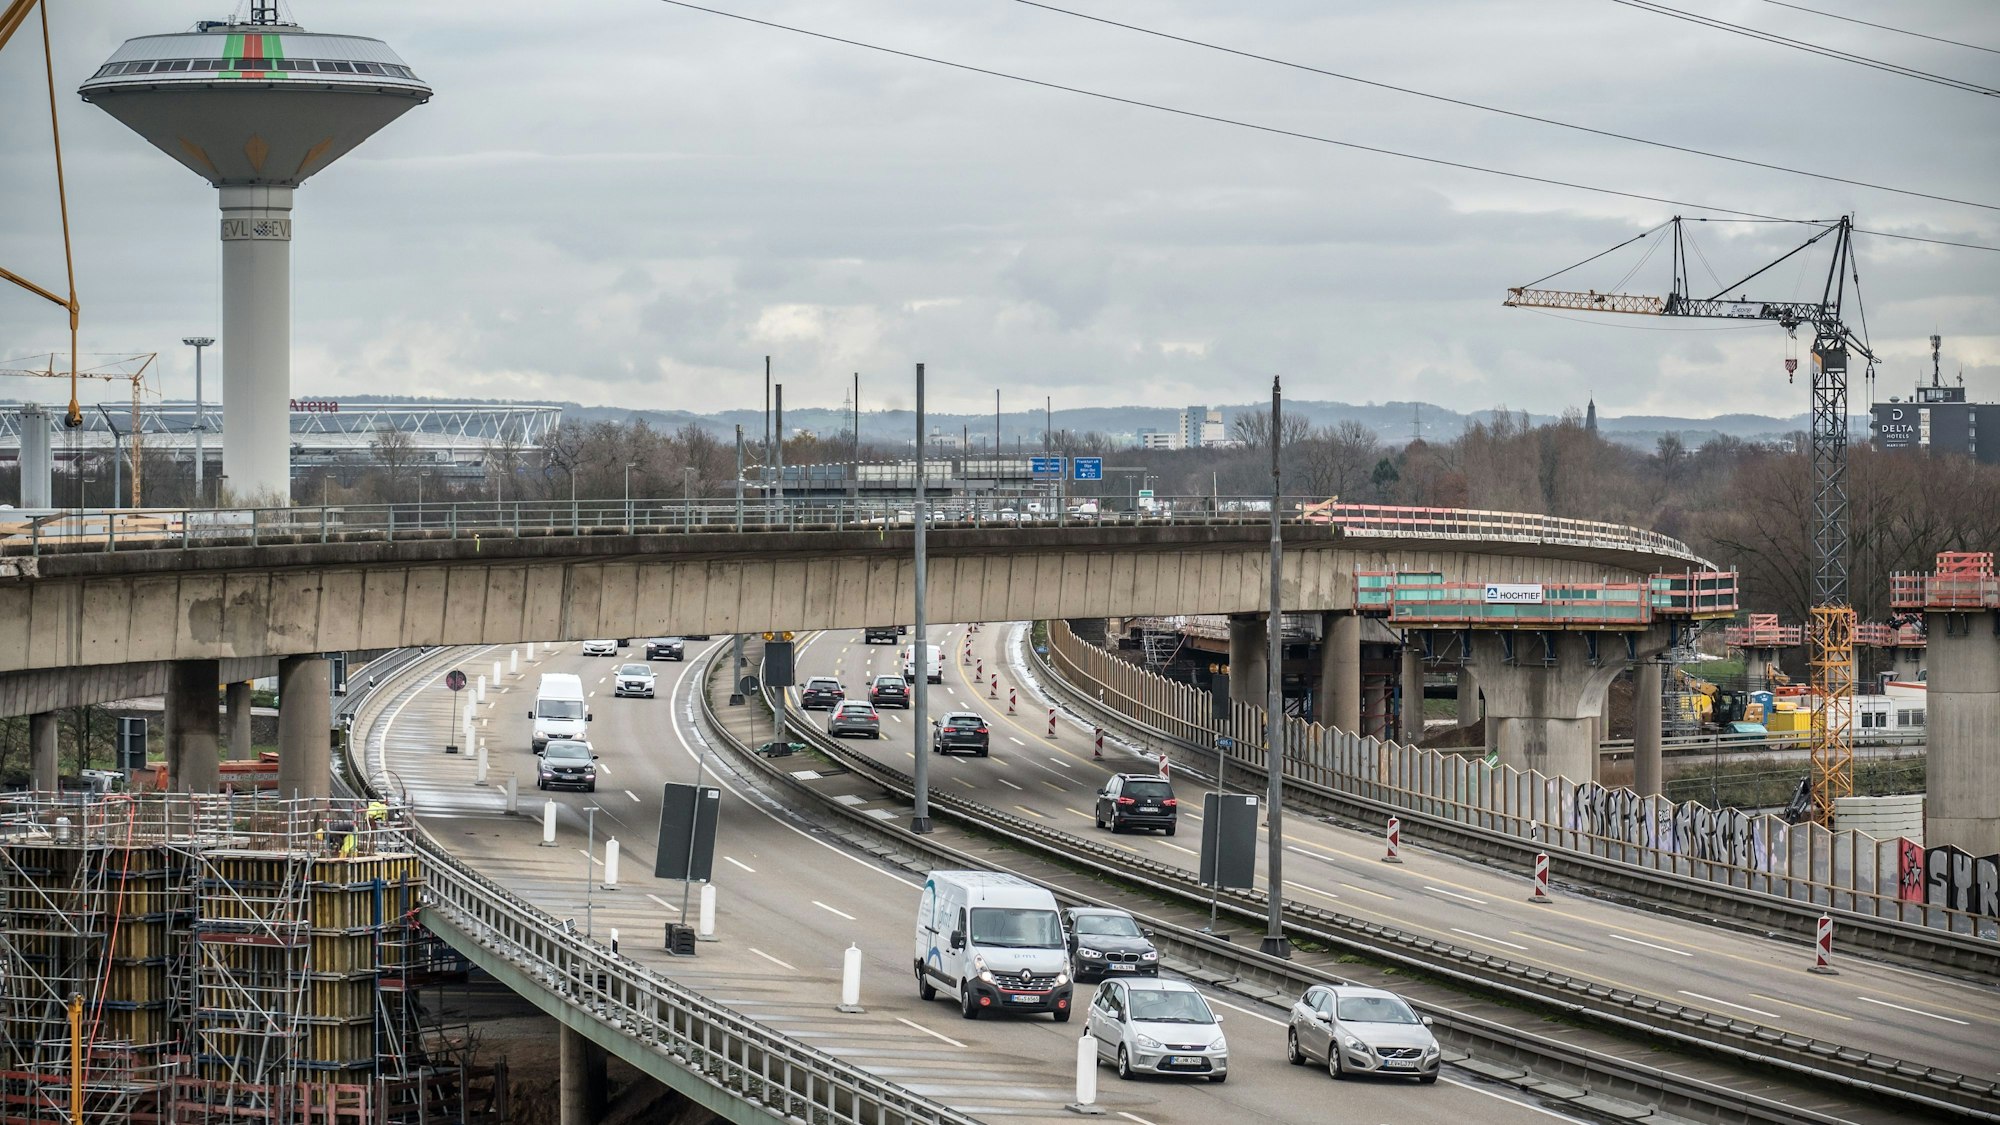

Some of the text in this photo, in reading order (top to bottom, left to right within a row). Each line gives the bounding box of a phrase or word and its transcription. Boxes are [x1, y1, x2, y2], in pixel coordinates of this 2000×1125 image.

[224, 221, 248, 236] EVL
[290, 399, 338, 413] Arena
[1500, 592, 1540, 600] HOCHTIEF
